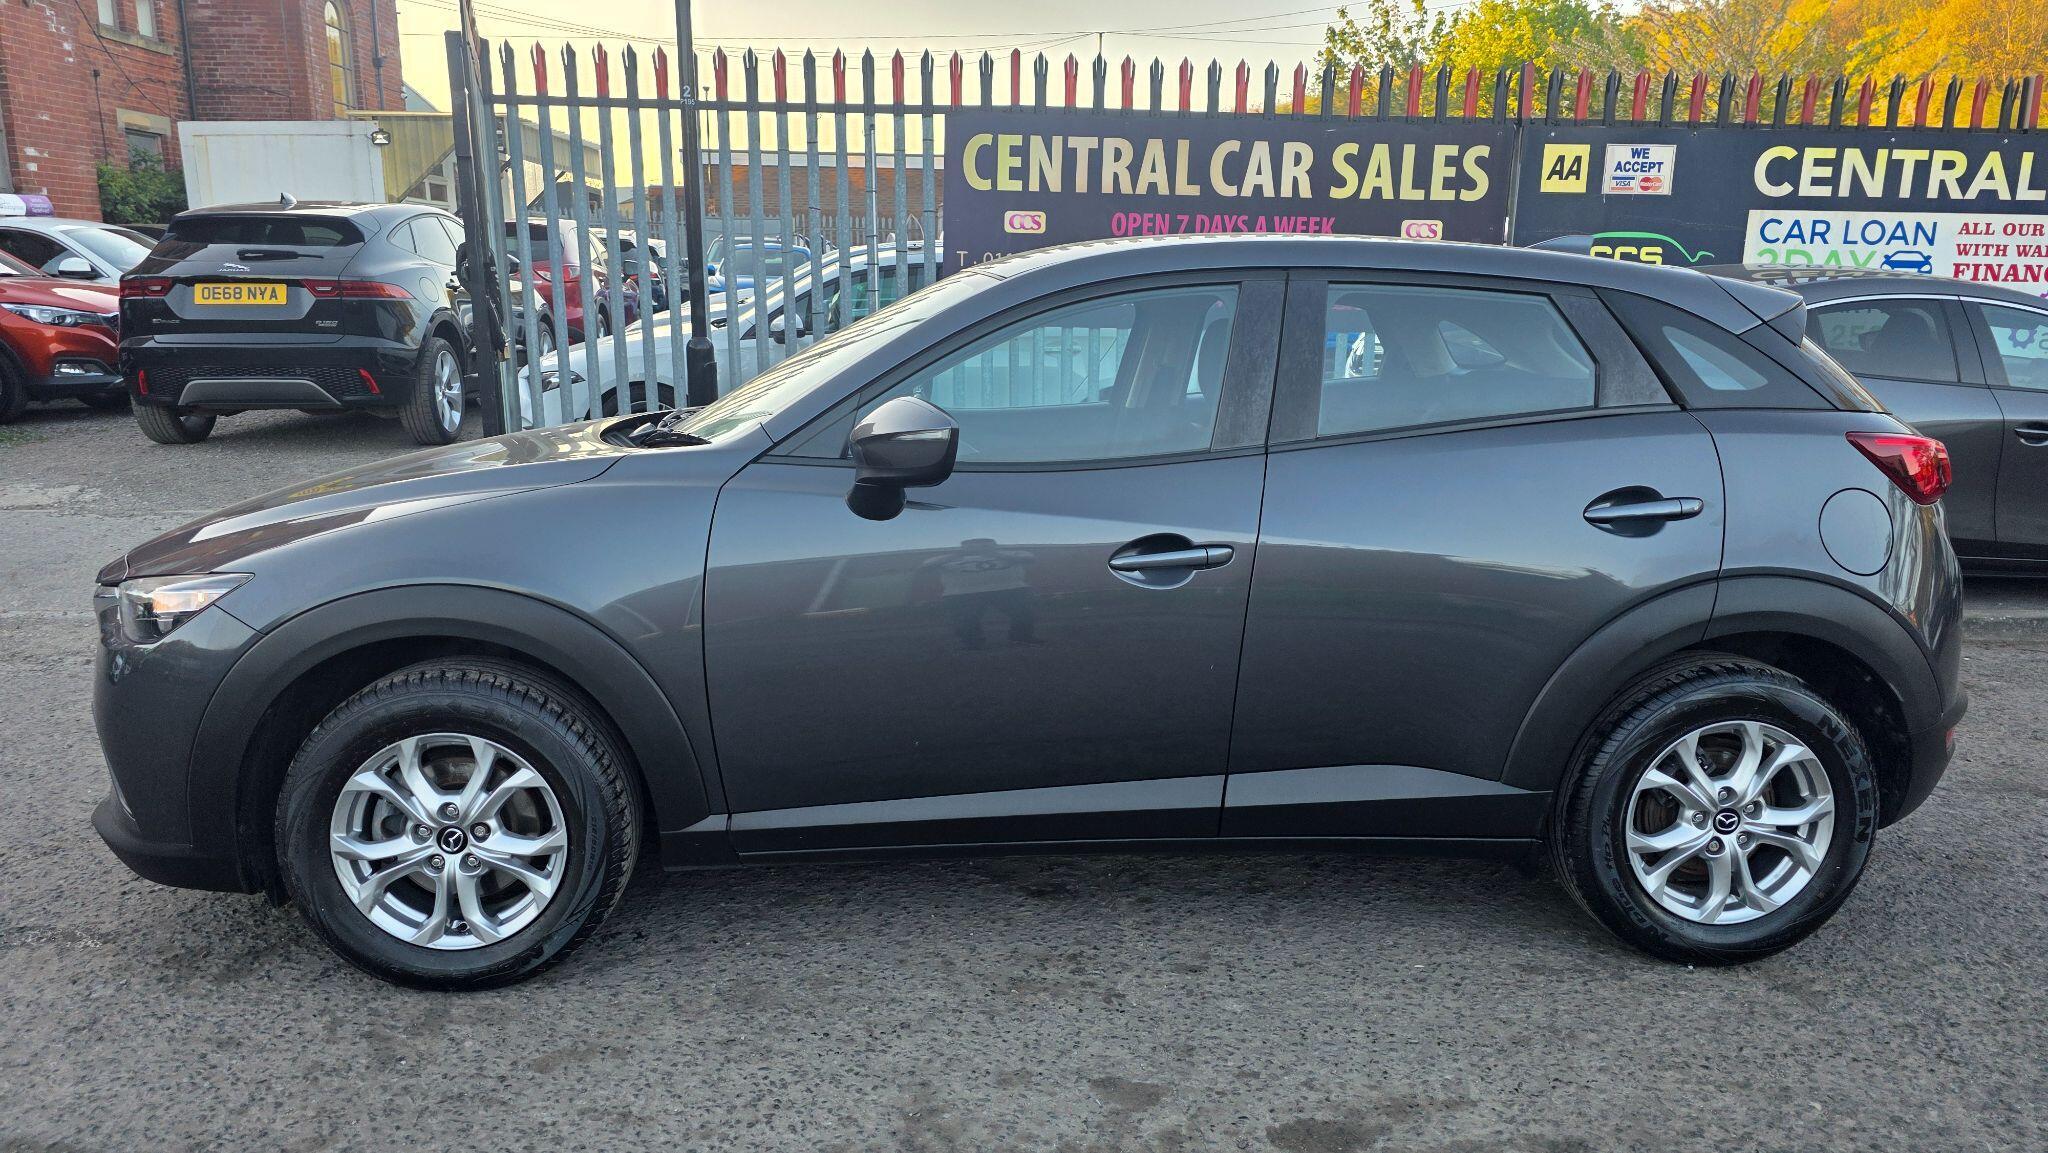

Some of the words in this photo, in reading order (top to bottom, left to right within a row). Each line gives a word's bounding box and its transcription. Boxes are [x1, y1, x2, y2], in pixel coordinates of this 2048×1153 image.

[683, 85, 690, 97] 2
[1631, 148, 1651, 160] WE
[962, 133, 1201, 196] CENTRAL
[1209, 139, 1313, 199] CAR
[1329, 142, 1491, 202] SALES
[1546, 154, 1583, 181] AA
[1614, 161, 1665, 174] ACCEPT
[1753, 145, 2047, 201] CENTRAL
[1008, 213, 1042, 231] CCS
[1111, 212, 1171, 236] OPEN
[1176, 214, 1191, 234] 7
[1195, 214, 1249, 234] DAYS
[1254, 215, 1267, 233] A
[1273, 215, 1336, 234] WEEK
[1405, 222, 1438, 239] CCS
[1958, 222, 1996, 236] ALL
[2002, 223, 2045, 236] OUR
[1759, 217, 1831, 245] CAR
[1842, 219, 1938, 247] LOAN
[1955, 243, 2010, 257] WITH
[2016, 244, 2048, 258] WA
[1952, 263, 2048, 282] FINAN
[201, 286, 243, 300] OE68
[247, 286, 278, 301] NYA
